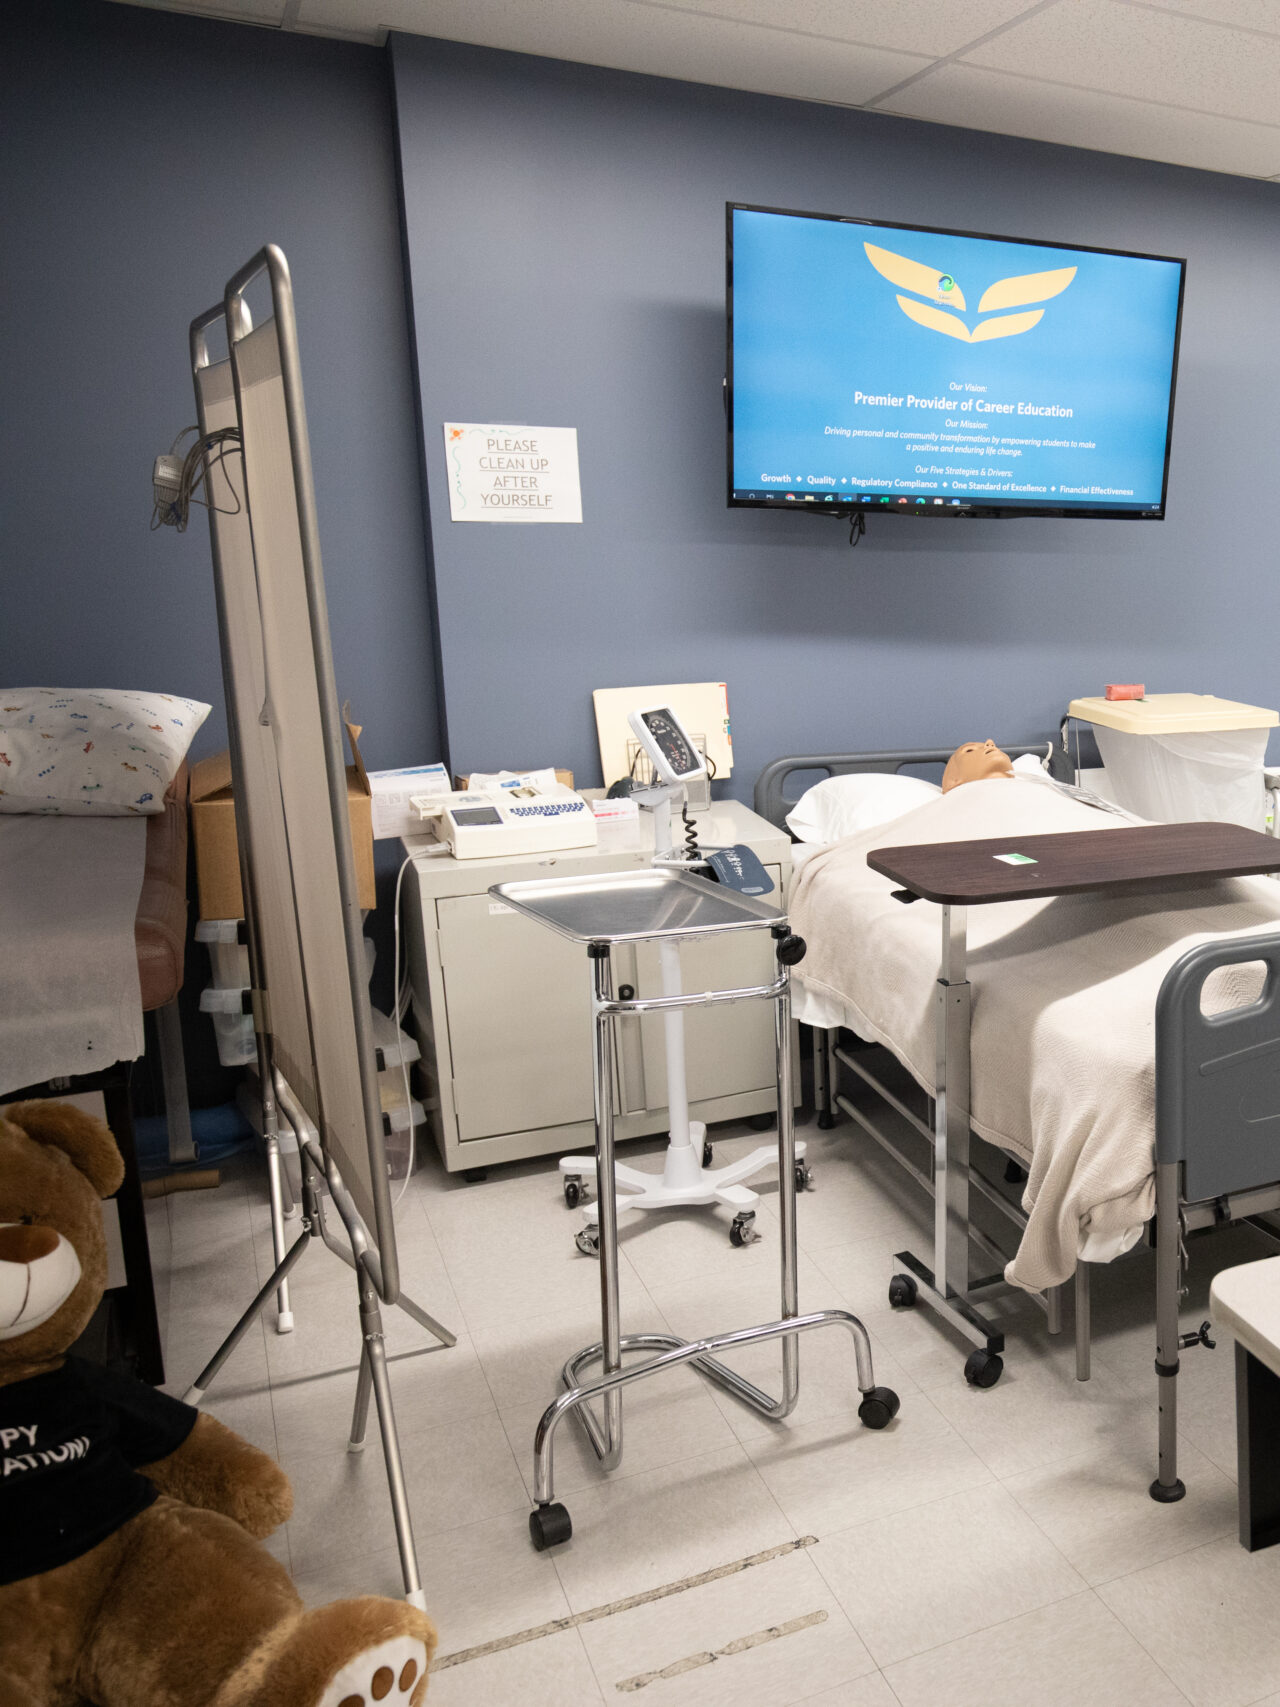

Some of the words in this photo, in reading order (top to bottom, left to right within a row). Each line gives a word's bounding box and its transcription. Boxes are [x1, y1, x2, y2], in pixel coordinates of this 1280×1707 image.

[949, 382, 963, 392] Our
[964, 383, 987, 393] Vision:
[854, 391, 904, 407] Premier
[907, 394, 958, 411] Provider
[960, 398, 973, 412] of
[976, 400, 1014, 414] Career
[1018, 402, 1073, 418] Education
[945, 419, 958, 428] Our
[960, 420, 988, 429] Mission:
[824, 426, 851, 437] Driving
[852, 428, 884, 440] personal
[884, 430, 899, 439] and
[900, 431, 939, 442] community
[940, 433, 990, 444] transformation
[992, 435, 1000, 445] by
[1001, 437, 1041, 448] empowering
[1042, 438, 1069, 448] students
[1070, 440, 1078, 448] to
[1078, 440, 1096, 449] make
[487, 438, 538, 452] PLEASE
[912, 443, 939, 453] positive
[940, 444, 953, 453] and
[954, 445, 984, 456] enduring
[985, 446, 996, 456] life
[997, 447, 1023, 457] change.
[479, 457, 525, 470] CLEAN
[530, 458, 549, 471] UP
[915, 465, 929, 474] Our
[930, 466, 944, 475] Five
[945, 466, 979, 477] Strategies
[980, 468, 986, 476] &
[987, 469, 1013, 478] Drivers:
[493, 476, 538, 488] AFTER
[761, 473, 792, 483] Growth
[807, 475, 836, 486] Quality
[851, 477, 893, 488] Regulatory
[894, 478, 938, 489] Compliance
[952, 481, 968, 490] One
[969, 481, 1001, 491] Standard
[1002, 483, 1010, 491] of
[1011, 484, 1047, 493] Excellence
[1060, 485, 1089, 494] Financial
[1091, 486, 1134, 496] Effectiveness
[480, 494, 552, 507] YOURSELF
